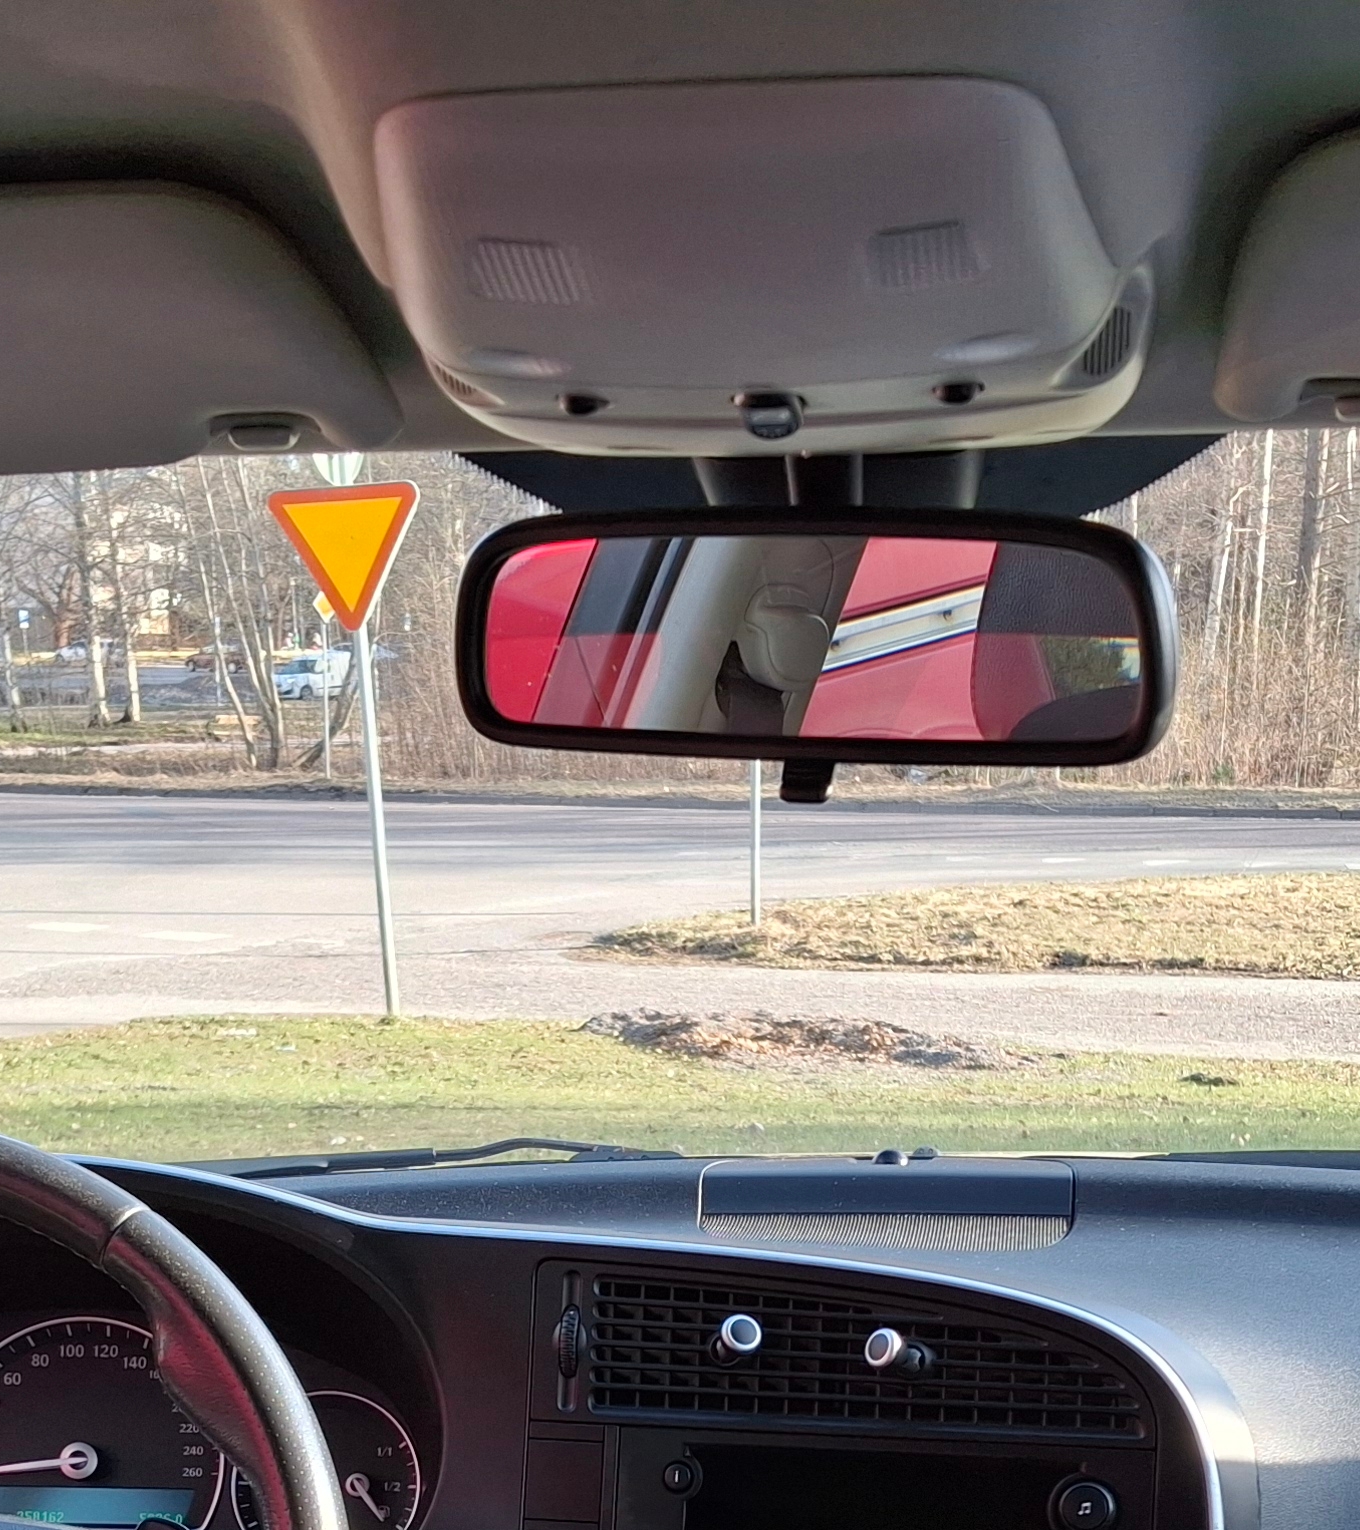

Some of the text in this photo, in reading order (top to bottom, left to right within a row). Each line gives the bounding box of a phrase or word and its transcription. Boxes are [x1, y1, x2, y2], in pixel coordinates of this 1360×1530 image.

[60, 1344, 85, 1358] 100
[94, 1345, 118, 1358] 120
[31, 1353, 50, 1367] 80
[123, 1356, 147, 1369] 140
[3, 1372, 22, 1386] 60
[179, 1423, 200, 1434] 220
[183, 1445, 204, 1456] 240
[377, 1446, 392, 1457] 1/1
[182, 1467, 203, 1477] 260
[384, 1481, 400, 1492] 1/2
